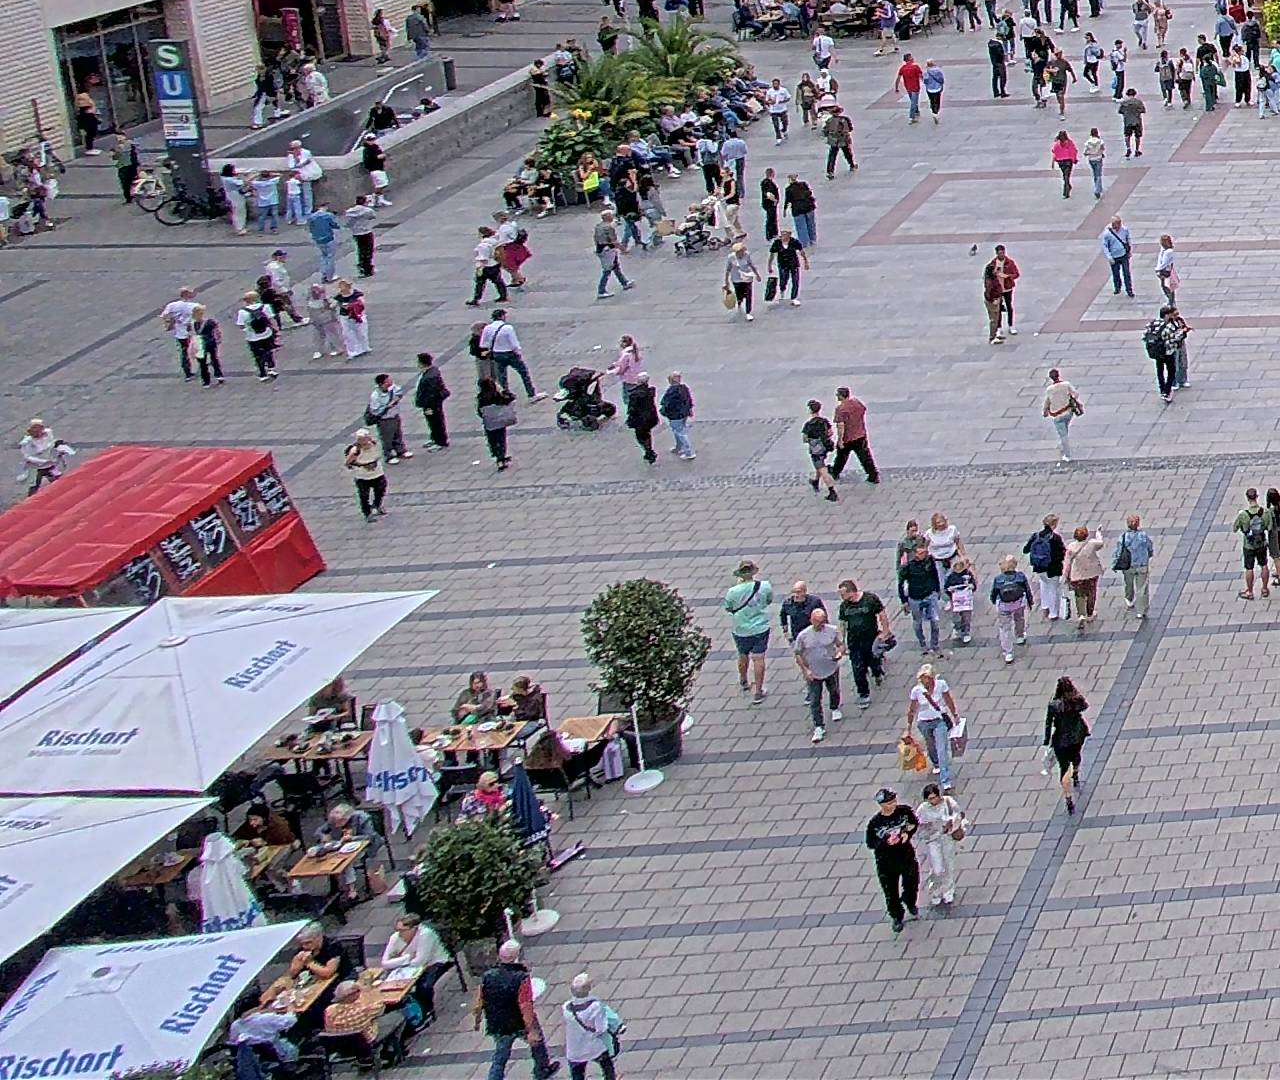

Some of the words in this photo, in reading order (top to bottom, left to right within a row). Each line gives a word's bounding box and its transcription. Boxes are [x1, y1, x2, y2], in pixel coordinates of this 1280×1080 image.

[158, 45, 179, 67] S
[163, 74, 182, 96] U
[223, 638, 298, 690] Rischart
[36, 727, 140, 747] Rischart
[159, 952, 247, 1035] Rischart
